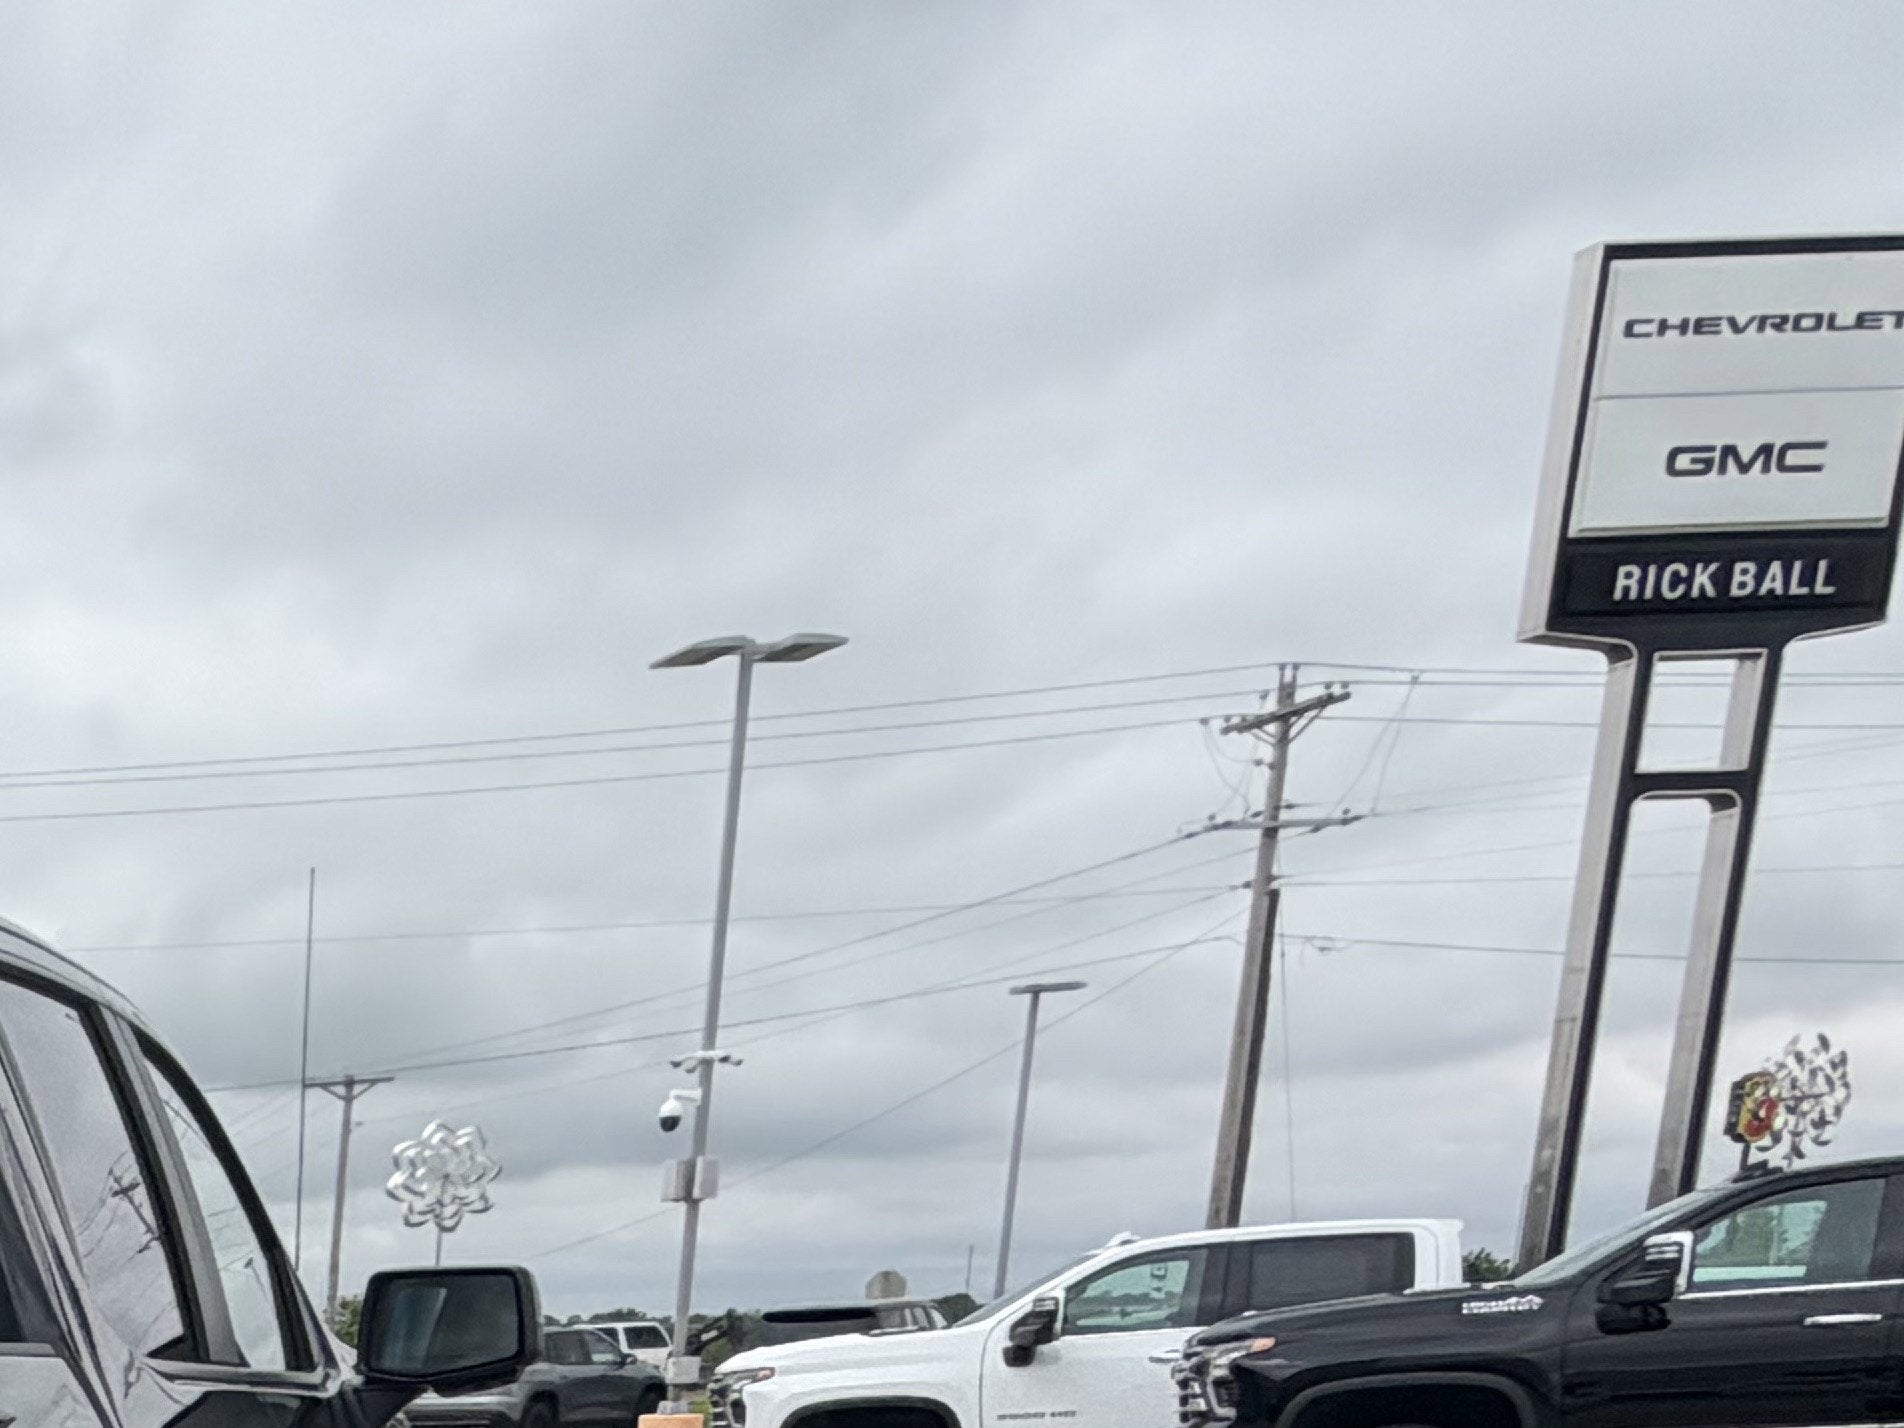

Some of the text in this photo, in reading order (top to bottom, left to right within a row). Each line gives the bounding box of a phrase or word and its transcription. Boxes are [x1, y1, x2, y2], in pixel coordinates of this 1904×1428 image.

[1623, 310, 1904, 338] CHEVROLET
[1665, 440, 1828, 477] GMC
[1612, 559, 1837, 600] RICK BALL
